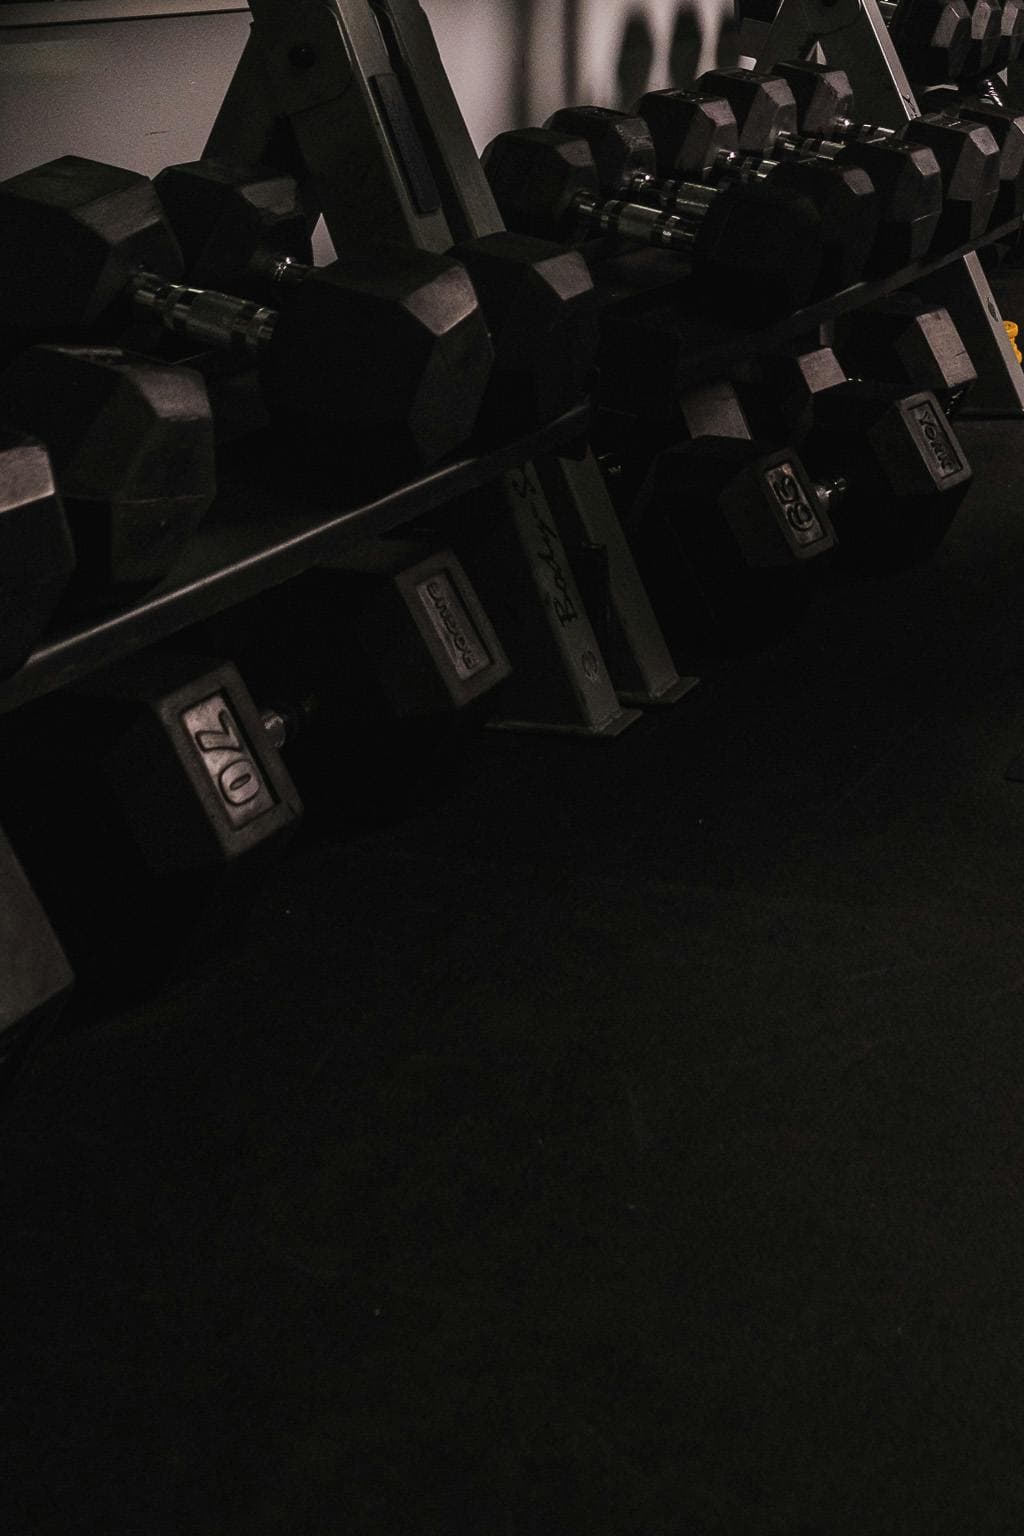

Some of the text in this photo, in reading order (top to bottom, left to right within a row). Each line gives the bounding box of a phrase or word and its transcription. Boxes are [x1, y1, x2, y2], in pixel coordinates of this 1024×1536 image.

[918, 410, 953, 470] YORK
[773, 474, 814, 532] 65
[195, 709, 262, 807] 70
